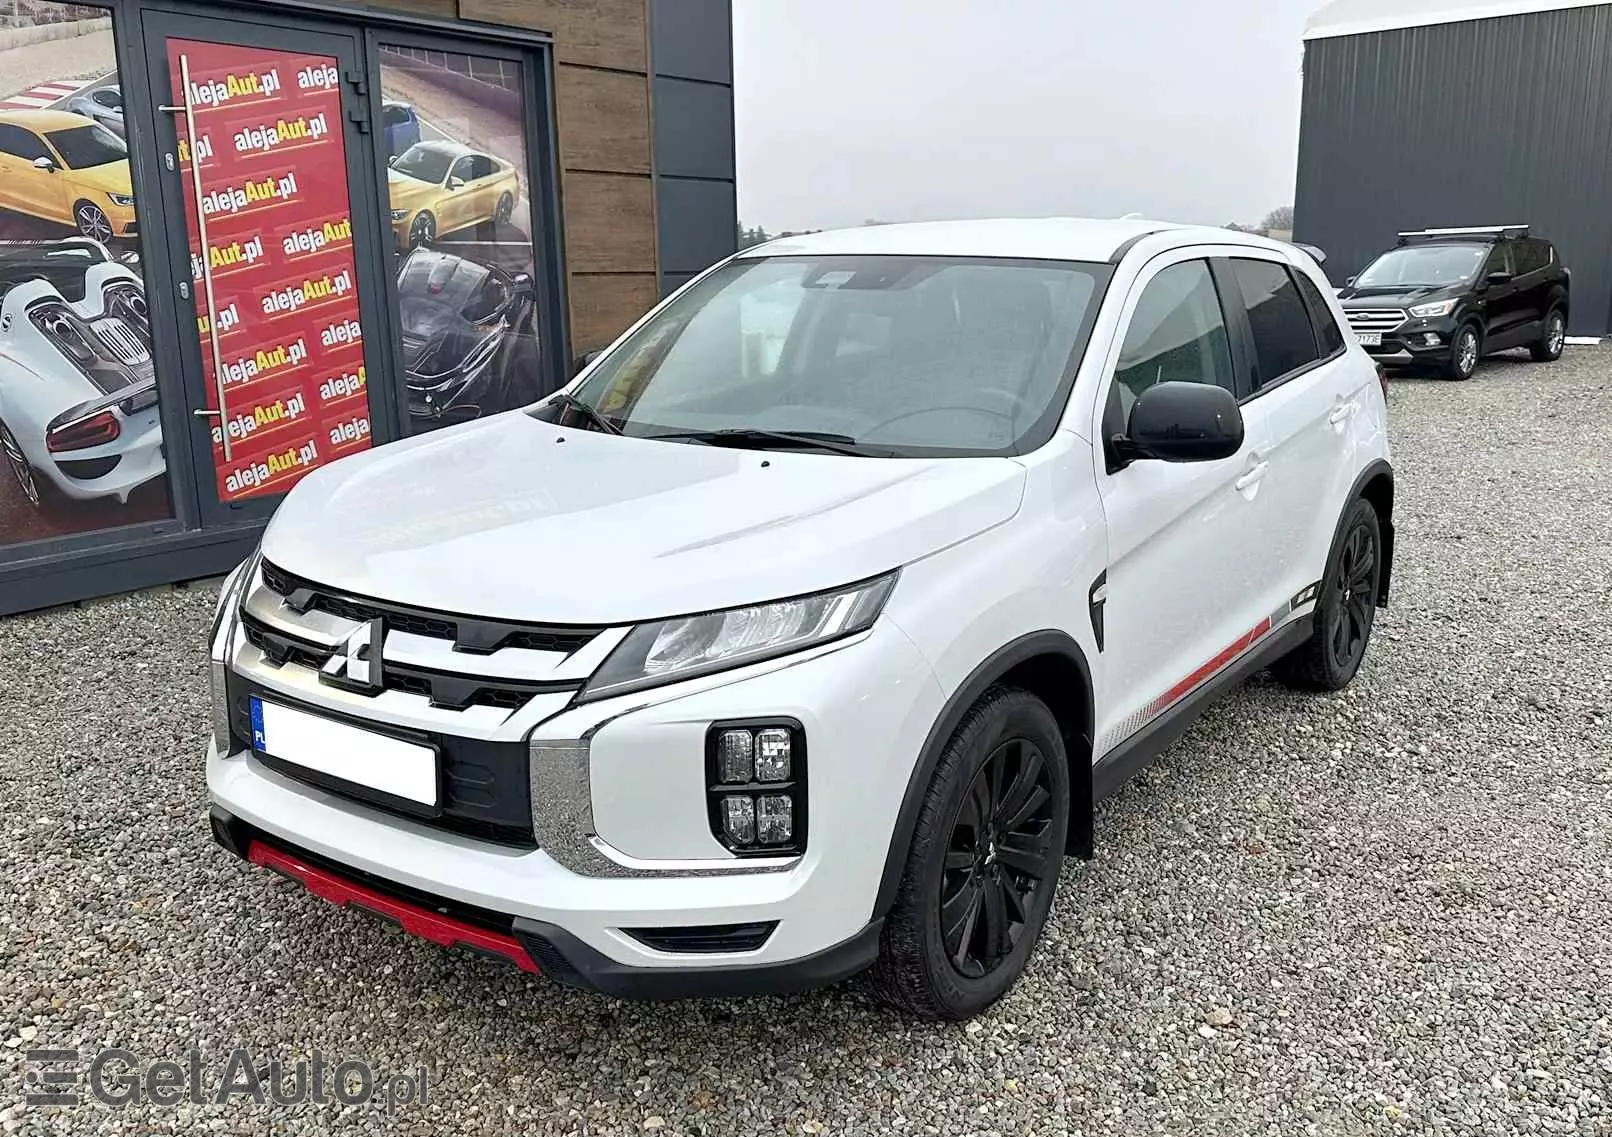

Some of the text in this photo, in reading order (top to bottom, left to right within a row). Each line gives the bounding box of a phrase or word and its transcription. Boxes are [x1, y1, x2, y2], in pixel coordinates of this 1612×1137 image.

[182, 69, 281, 107] lejaAut.pl
[298, 63, 339, 89] aleja
[234, 113, 328, 151] alejaAut.pl
[203, 172, 297, 214] alejaAut.pl
[262, 270, 352, 314] alejaAut.pl
[320, 319, 362, 347] aleja
[213, 339, 307, 385] lejaAut.pl
[211, 393, 306, 443] aejaAut.pl
[329, 416, 371, 445] aleja
[226, 440, 318, 493] alejaAut.pl
[255, 731, 266, 744] PL
